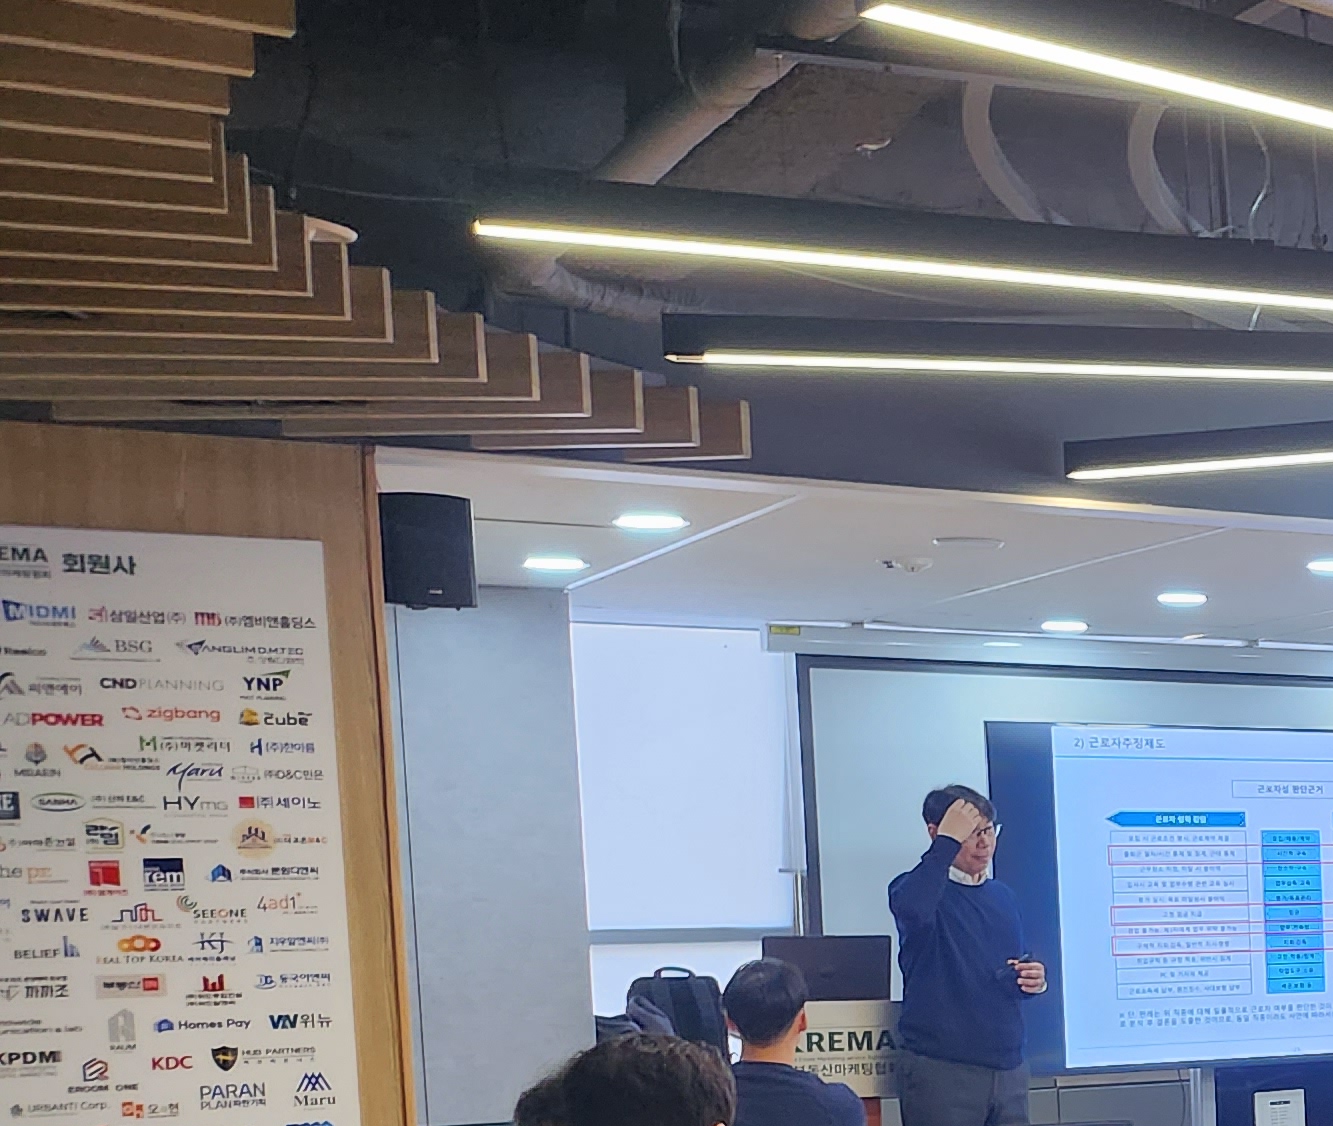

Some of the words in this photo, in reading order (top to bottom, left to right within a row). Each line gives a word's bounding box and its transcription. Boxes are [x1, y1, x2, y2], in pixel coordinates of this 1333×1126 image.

[62, 553, 137, 576] 회원사
[114, 639, 153, 653] BSG
[99, 677, 138, 691] CND
[243, 676, 284, 692] YNP
[2, 711, 105, 727] ADPOWER
[147, 705, 221, 723] zigbang
[1073, 737, 1085, 749] 2)
[1088, 736, 1166, 749] 근로자추정제도
[21, 907, 89, 923] SWAVE
[193, 908, 247, 920] SEEONE
[123, 955, 146, 964] TOP
[178, 1020, 223, 1030] Homes
[226, 1018, 251, 1031] Pay
[300, 1012, 333, 1029] 위뉴
[796, 1030, 896, 1053] REMA
[151, 1056, 194, 1070] KDC
[199, 1082, 266, 1100] PARAN
[200, 1100, 232, 1111] PLAN
[293, 1095, 337, 1108] Maru
